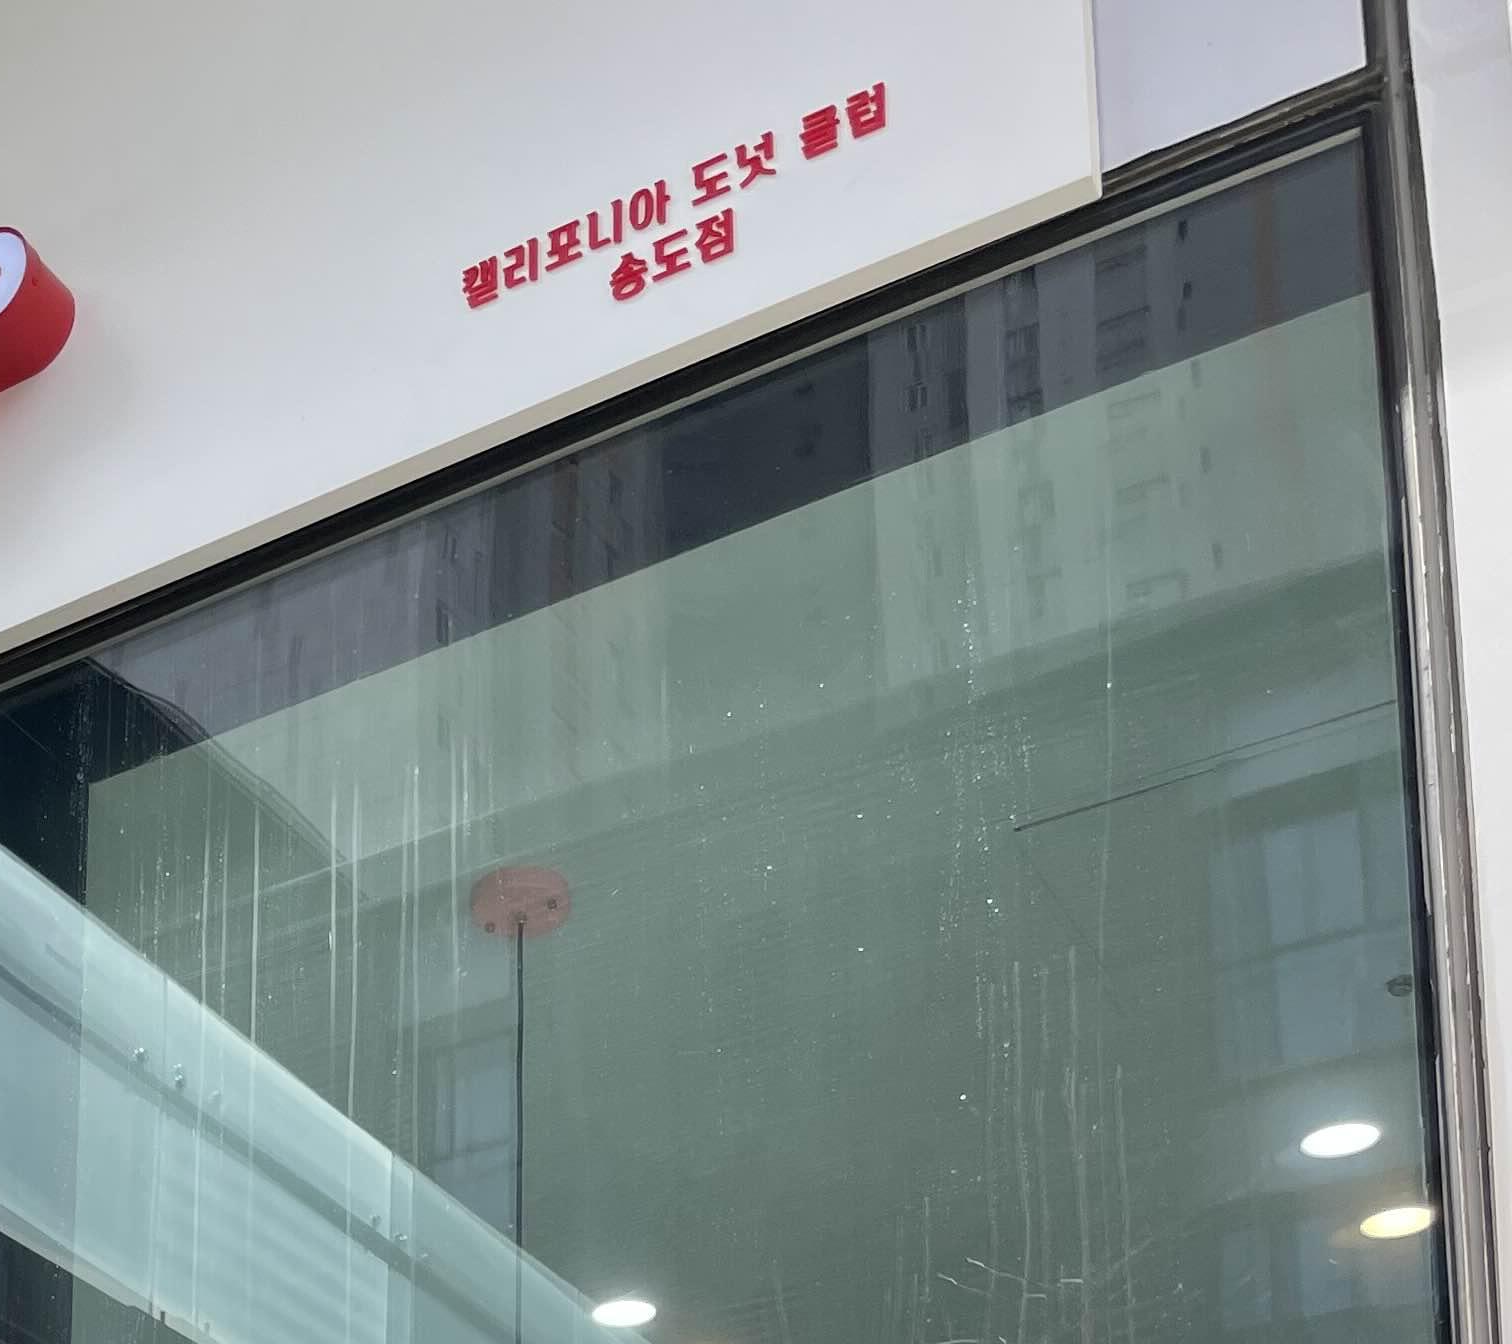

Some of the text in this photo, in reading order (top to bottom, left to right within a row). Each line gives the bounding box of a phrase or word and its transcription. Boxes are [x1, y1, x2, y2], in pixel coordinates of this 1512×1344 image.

[462, 81, 887, 310] 캘리포니아 도넛 클럽
[609, 207, 734, 301] 송도점
